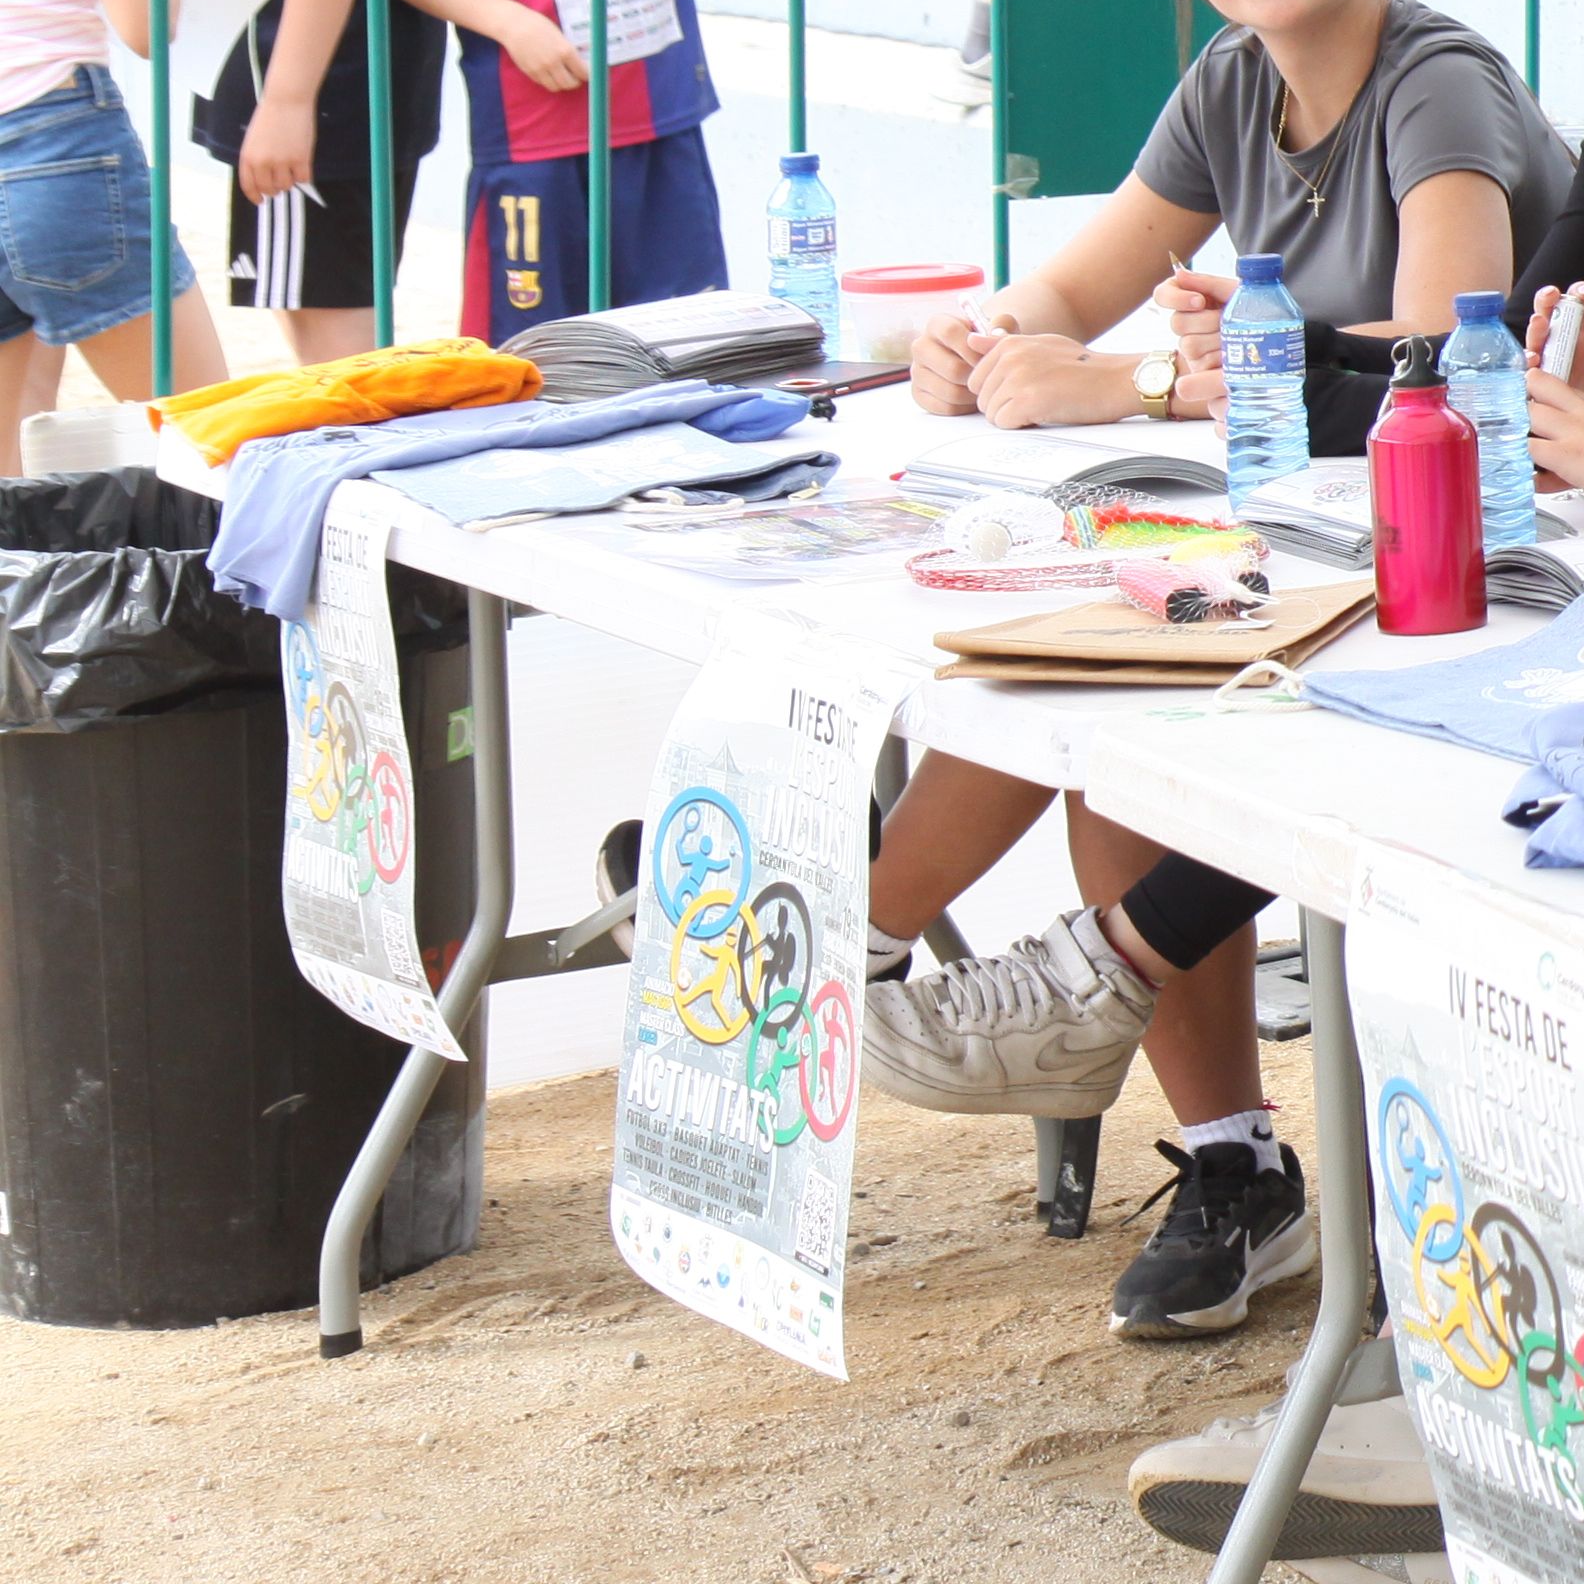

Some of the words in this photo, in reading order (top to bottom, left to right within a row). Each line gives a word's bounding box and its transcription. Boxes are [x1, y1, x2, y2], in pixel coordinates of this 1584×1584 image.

[499, 195, 540, 264] 11
[788, 688, 807, 732] IV
[286, 833, 359, 904] ACTIVITATS
[1449, 964, 1467, 1020] IV
[1475, 978, 1538, 1056] FESTA
[1543, 1011, 1572, 1072] DE
[627, 1047, 778, 1154] ACTIVITATS
[1458, 1022, 1579, 1142] L'ESPORT
[623, 1147, 644, 1170] TENNIS
[643, 1156, 664, 1178] TAULA
[668, 1166, 700, 1190] CROSSFIT
[626, 1107, 651, 1132] FUTBOL
[652, 1120, 668, 1138] 3X3
[708, 1138, 741, 1163] ADAPTAT
[746, 1155, 769, 1177] TENNIS
[635, 1133, 664, 1159] VOLEIBOL
[669, 1145, 698, 1169] CADIRES
